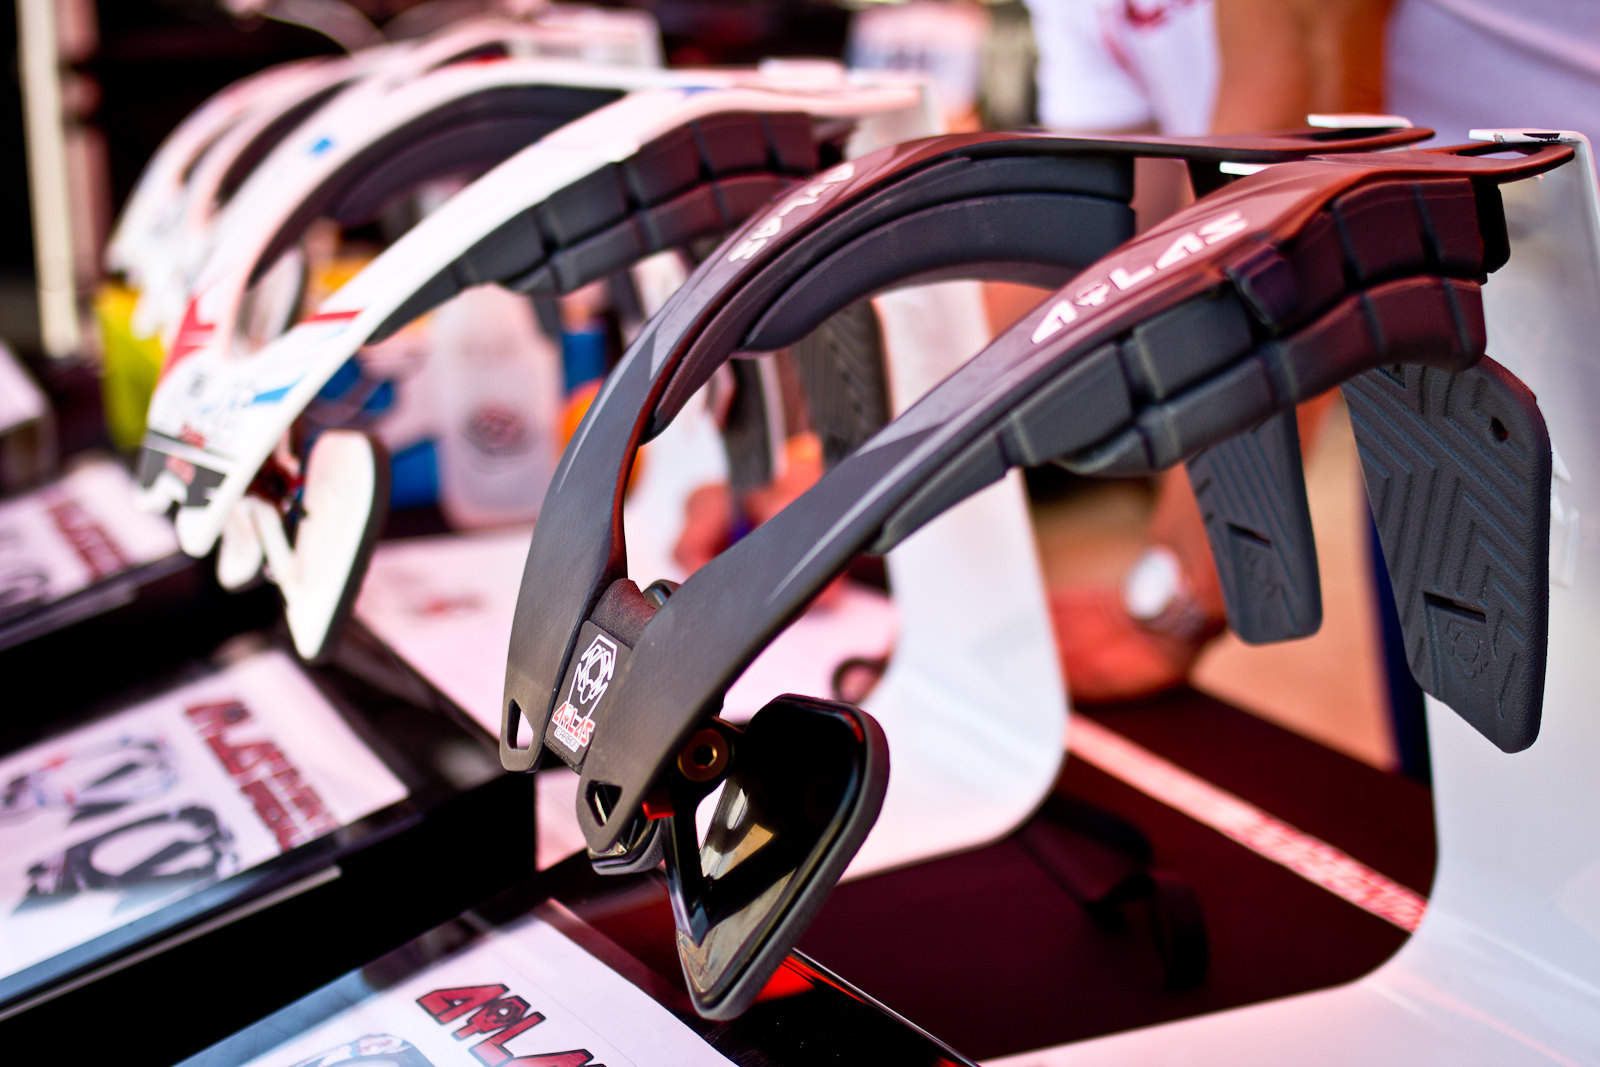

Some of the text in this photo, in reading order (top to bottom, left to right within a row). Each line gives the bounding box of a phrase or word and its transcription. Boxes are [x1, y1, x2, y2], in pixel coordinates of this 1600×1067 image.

[1031, 209, 1249, 345] ATLAS
[552, 702, 595, 746] ATLAS
[555, 727, 580, 750] CARBON
[415, 983, 607, 1067] ATL
